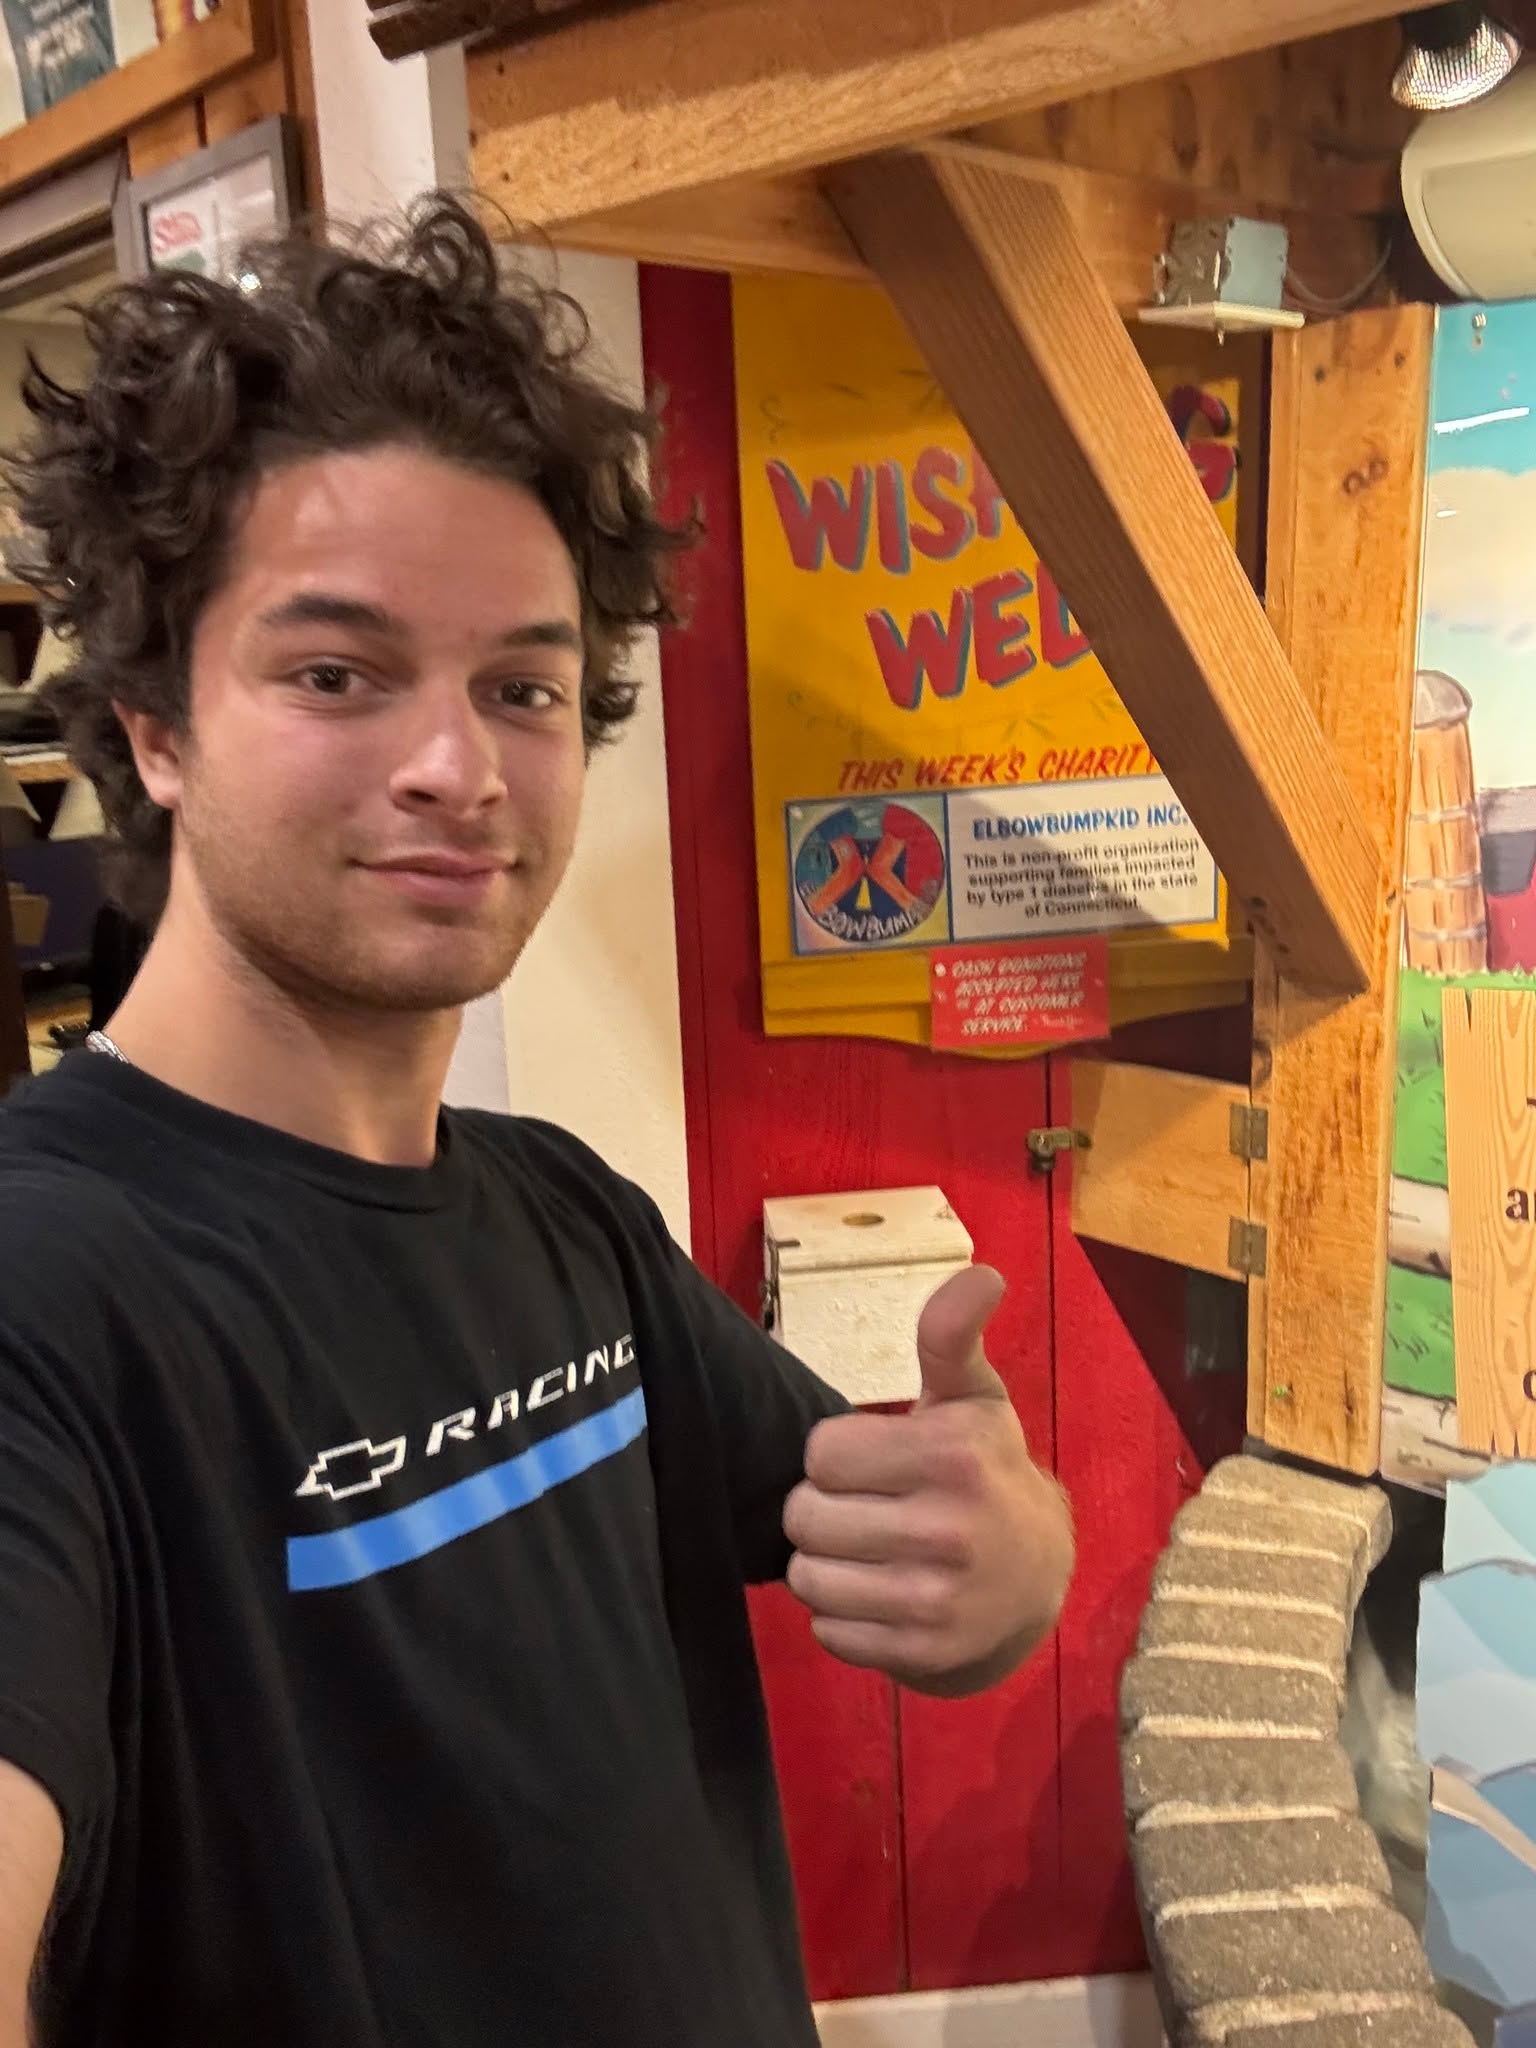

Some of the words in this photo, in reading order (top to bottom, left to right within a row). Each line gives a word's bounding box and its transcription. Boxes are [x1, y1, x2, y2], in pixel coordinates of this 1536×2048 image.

[837, 756, 903, 791] THIS
[915, 744, 1025, 786] WEEK'S
[972, 807, 1140, 841] ELBOWBUMPKID
[1147, 803, 1188, 829] INC.
[963, 851, 998, 869] This
[1003, 850, 1016, 865] is
[1021, 845, 1098, 866] non-profit
[1103, 837, 1199, 862] organization
[969, 867, 1055, 891] supporting
[1060, 862, 1120, 880] families
[1125, 853, 1195, 876] impacted
[967, 889, 986, 908] by
[990, 887, 1024, 907] type
[1114, 879, 1128, 894] in
[1132, 875, 1155, 892] the
[1160, 873, 1198, 890] state
[1025, 902, 1040, 918] of
[425, 1334, 637, 1457] RACING
